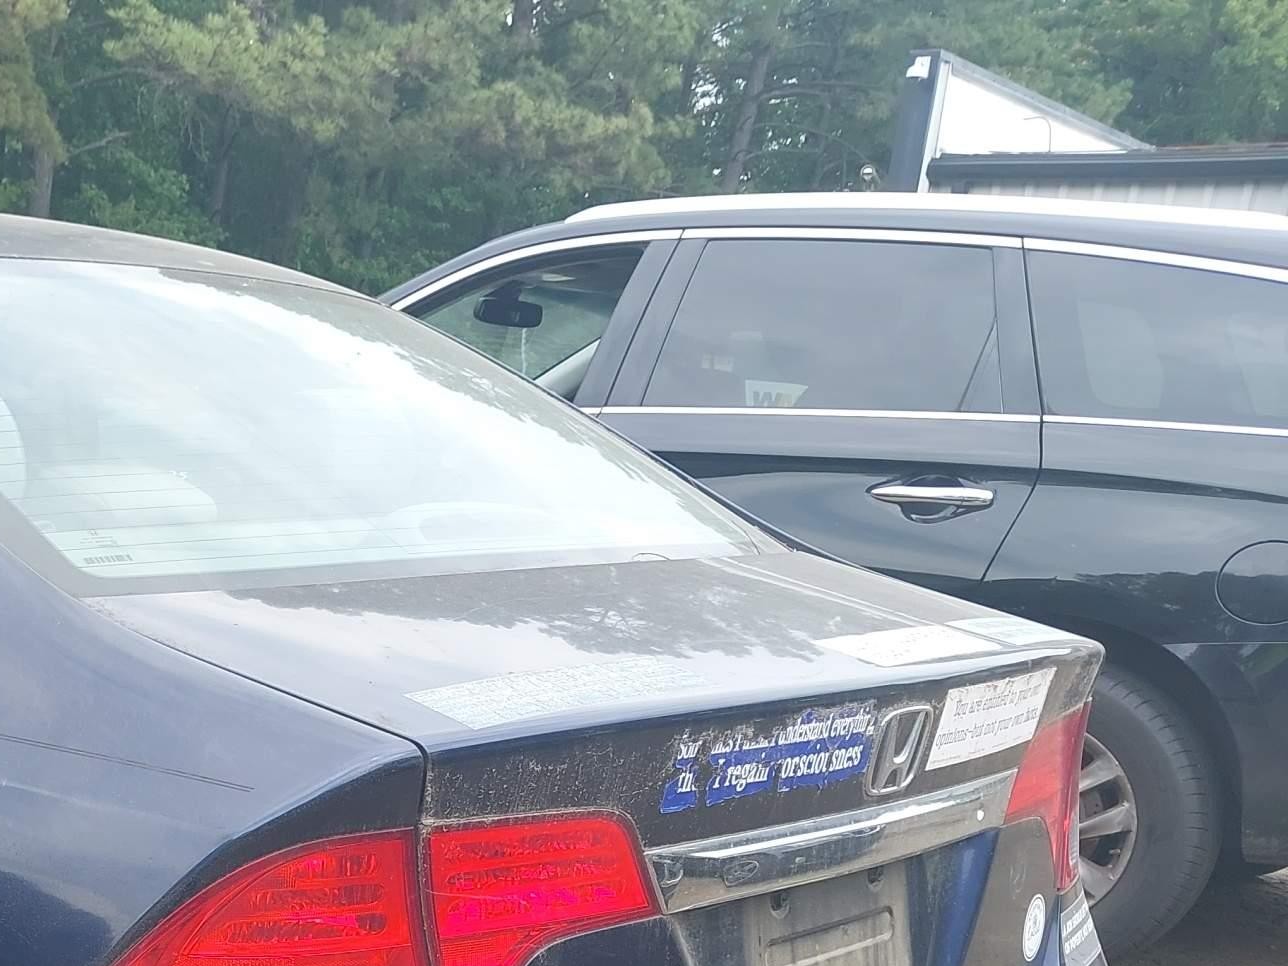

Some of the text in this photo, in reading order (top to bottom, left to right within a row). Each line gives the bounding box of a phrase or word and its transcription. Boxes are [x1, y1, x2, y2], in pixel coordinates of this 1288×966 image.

[953, 700, 969, 717] You
[968, 699, 983, 714] are
[982, 690, 1009, 712] entitled
[1014, 686, 1032, 707] your
[778, 713, 834, 747] understand
[994, 716, 1013, 737] your
